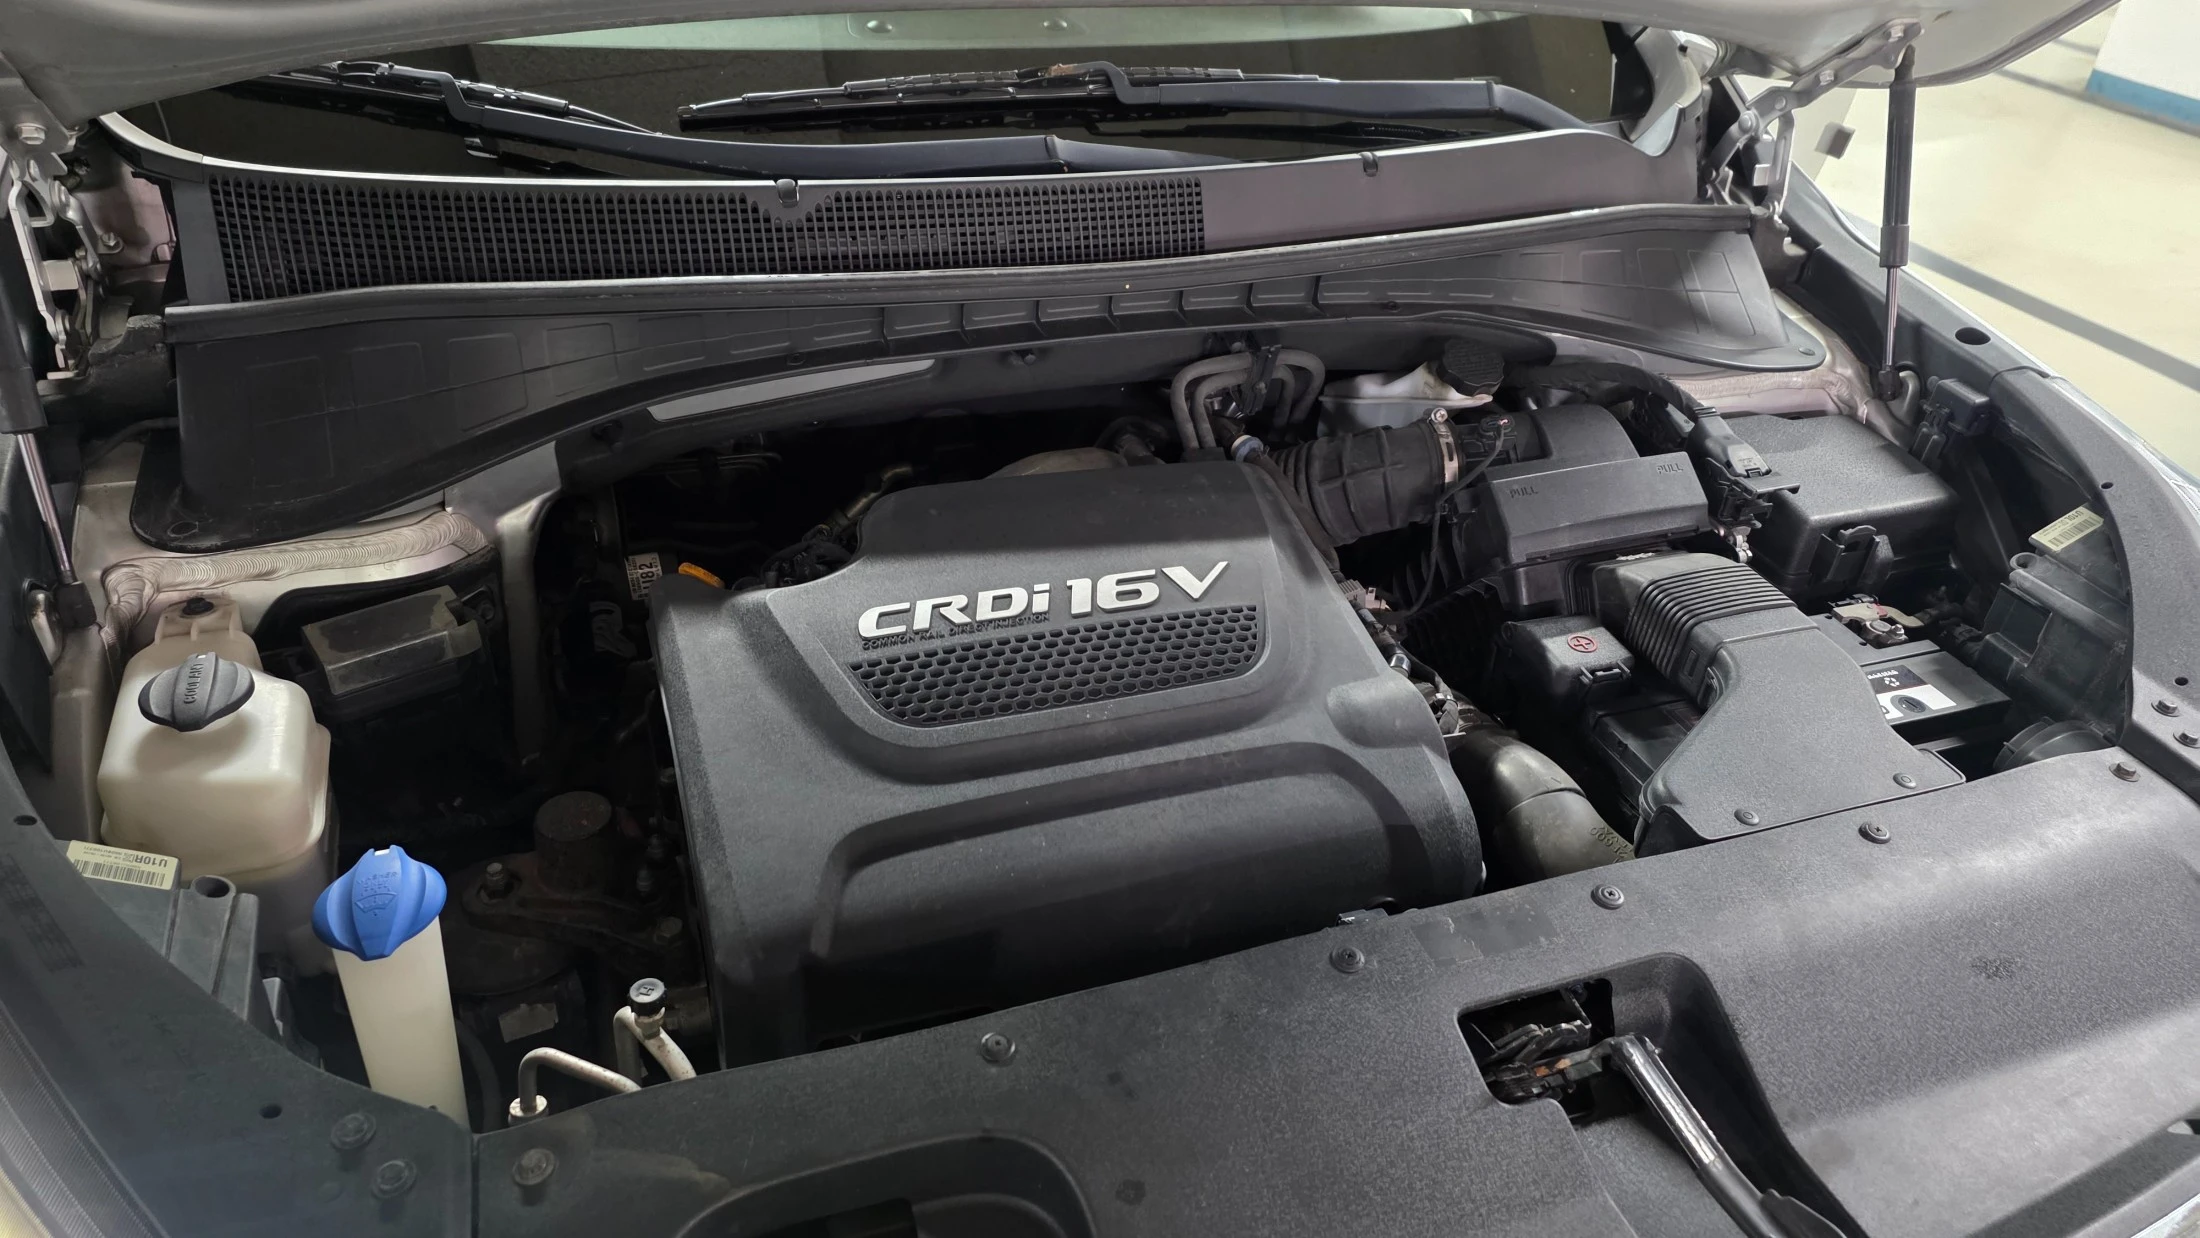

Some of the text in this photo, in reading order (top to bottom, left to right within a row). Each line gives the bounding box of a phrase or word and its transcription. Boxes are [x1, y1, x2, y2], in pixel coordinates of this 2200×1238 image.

[1656, 462, 1683, 475] PULL
[1509, 485, 1538, 499] PULL
[858, 583, 1050, 638] CRDi
[862, 613, 1050, 651] COMMON RAIL DIRECT INJECTION
[134, 854, 168, 868] U10R
